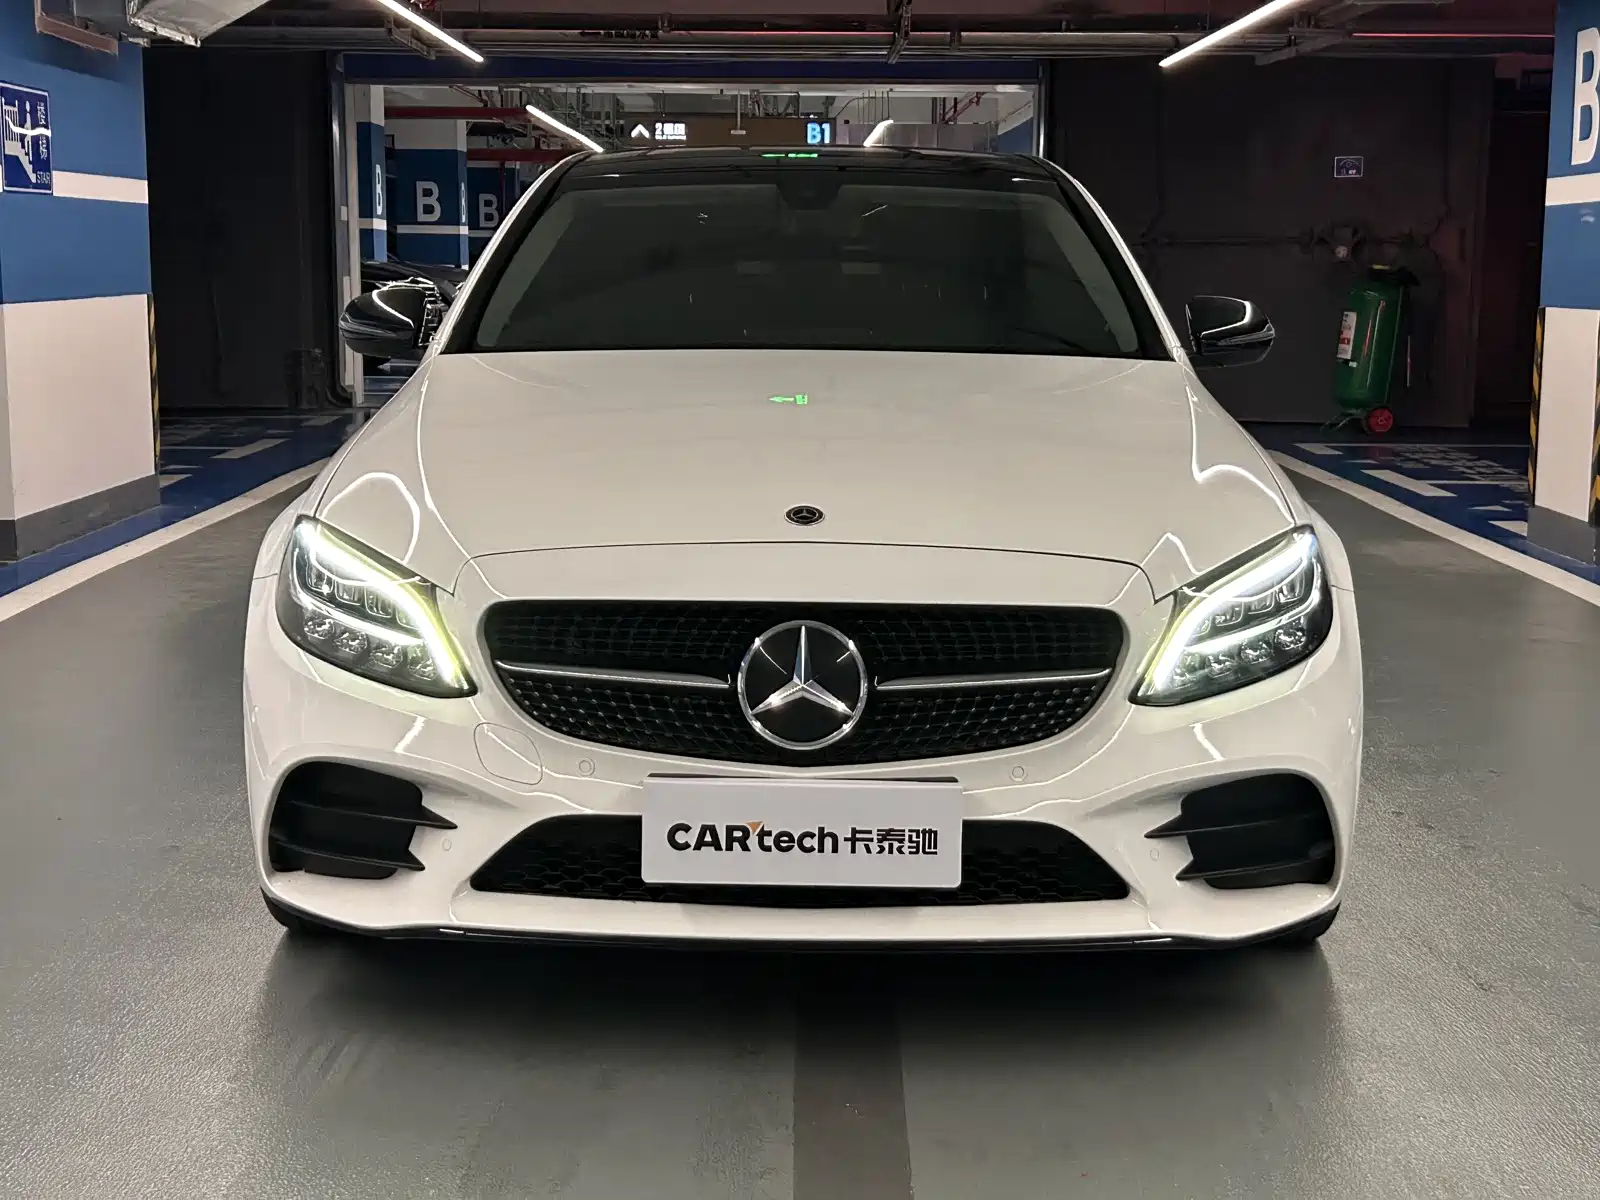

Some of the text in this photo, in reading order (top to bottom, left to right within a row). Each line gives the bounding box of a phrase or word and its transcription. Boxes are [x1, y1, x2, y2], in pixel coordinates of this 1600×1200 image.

[1571, 27, 1600, 165] B
[807, 122, 831, 144] B1
[375, 164, 383, 215] B
[416, 181, 441, 222] B
[478, 193, 500, 228] B
[844, 827, 939, 856] 卡泰驰
